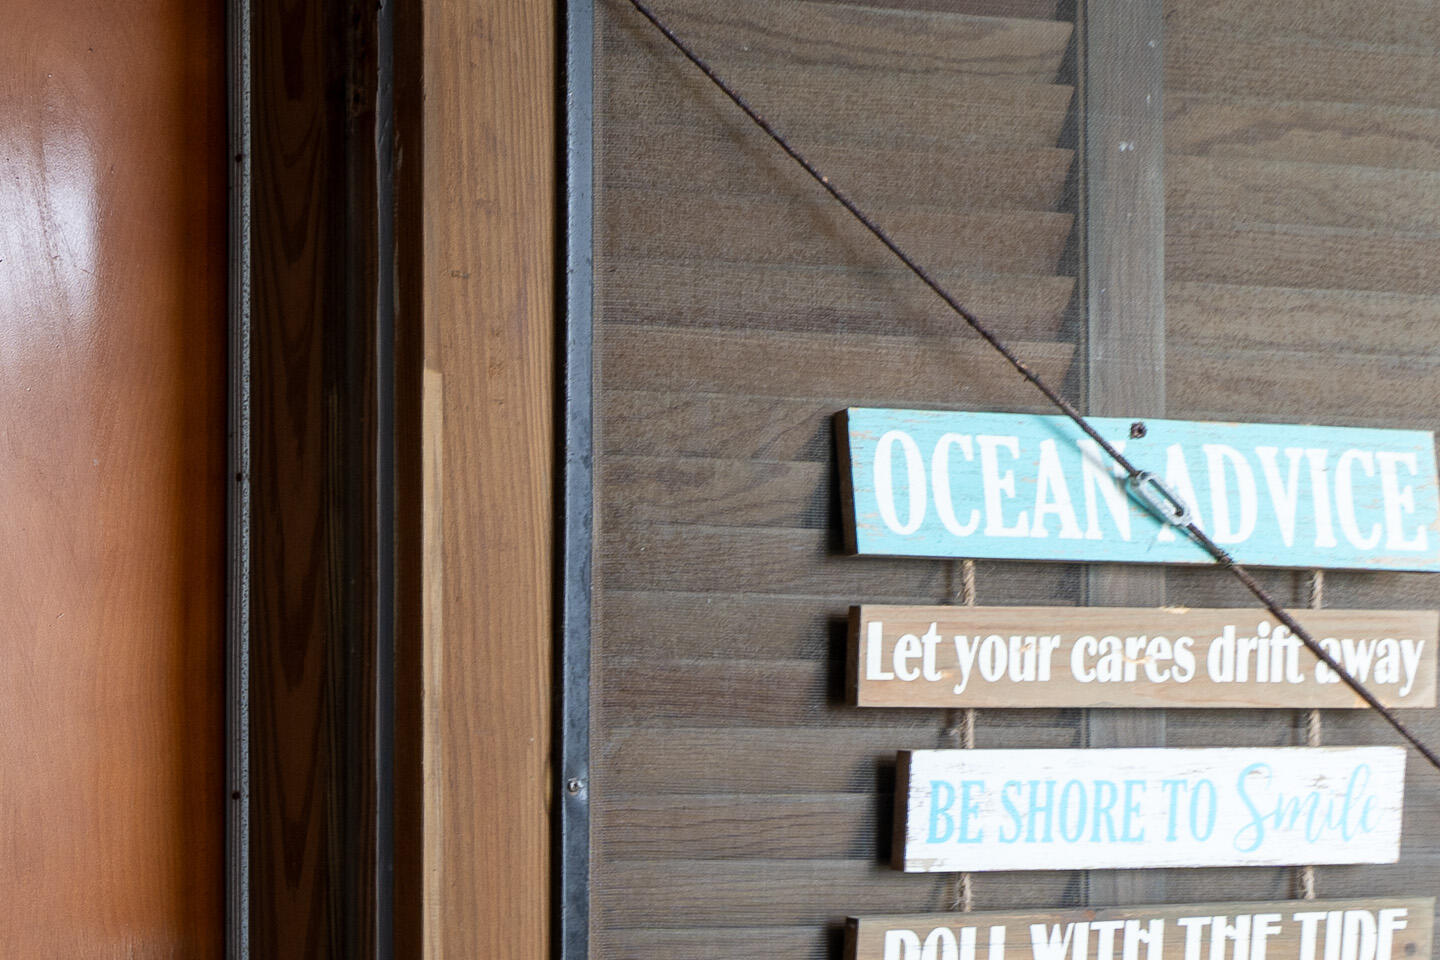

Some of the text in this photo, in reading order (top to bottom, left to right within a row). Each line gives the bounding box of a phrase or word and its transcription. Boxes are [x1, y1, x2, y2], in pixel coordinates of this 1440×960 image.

[872, 430, 1429, 552] OCEAN ADVICE
[865, 620, 1426, 698] Let your cares drift away
[925, 761, 1383, 853] BE SHORE TO Smile
